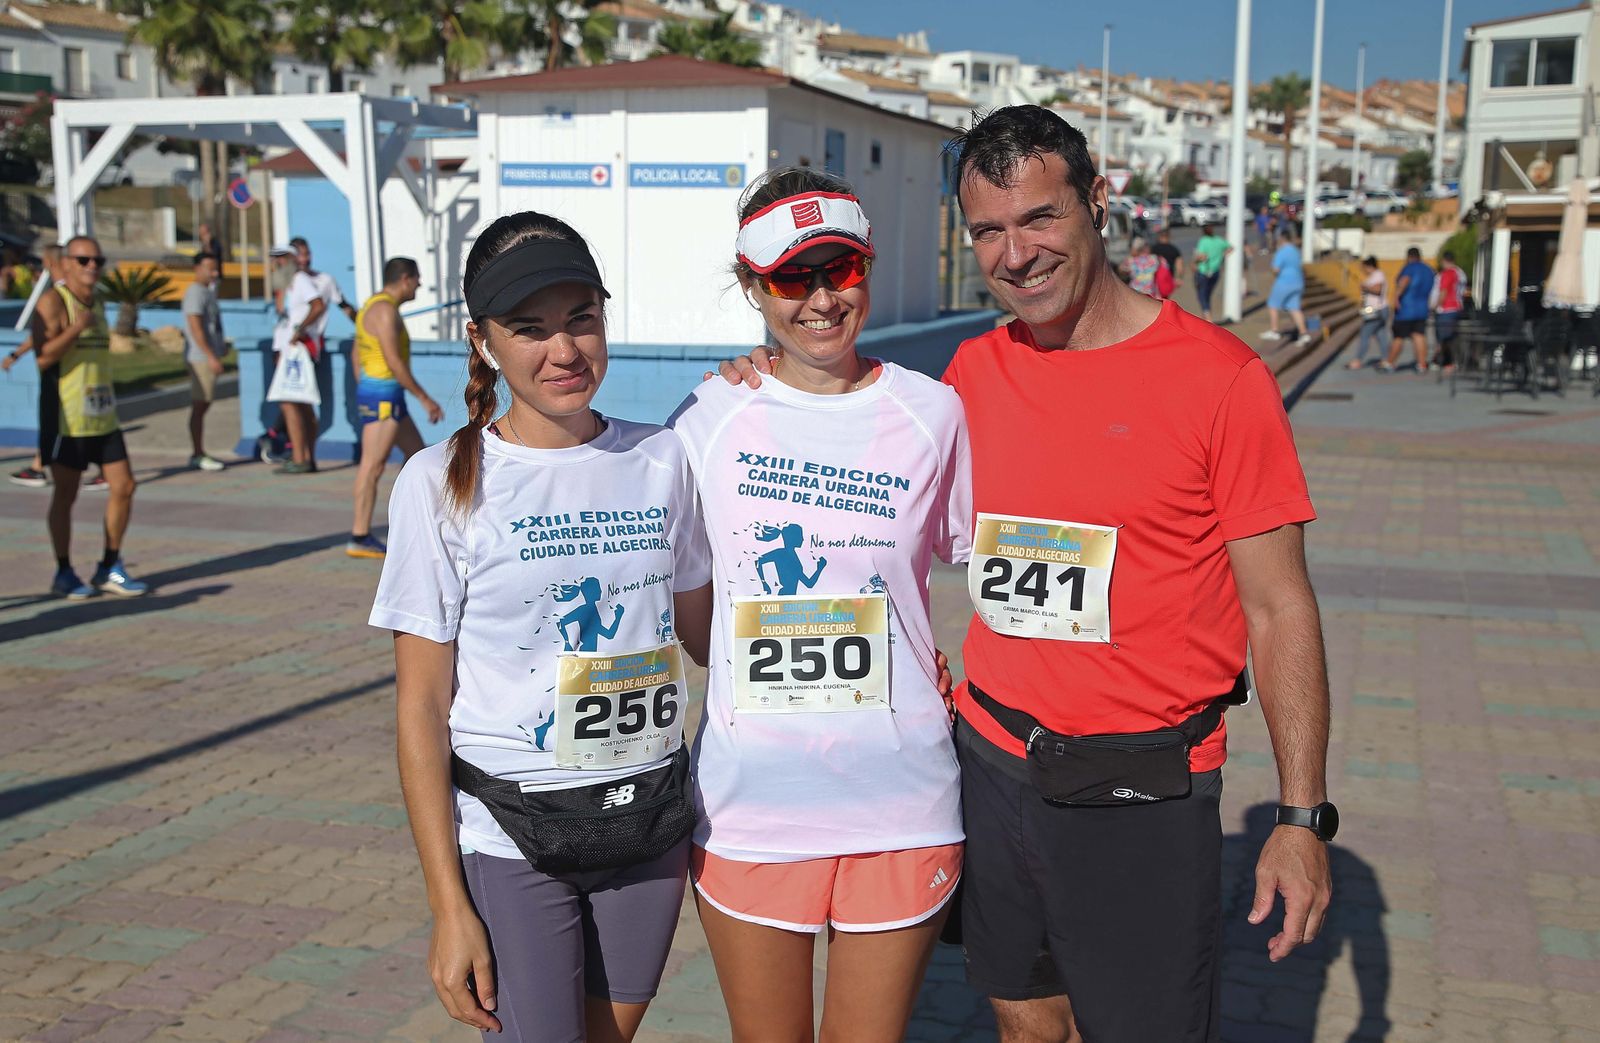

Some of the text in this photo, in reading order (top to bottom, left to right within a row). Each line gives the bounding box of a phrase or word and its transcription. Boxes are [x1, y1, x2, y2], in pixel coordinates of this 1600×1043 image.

[503, 168, 590, 181] PRIMEROS AUXILIOS
[683, 168, 720, 183] LOCAL
[736, 451, 910, 491] XXIII EDICIÓN
[748, 469, 890, 502] CARRERA URBANA
[738, 483, 897, 520] CIUDAD DE ALGECIRAS
[509, 513, 571, 534] XXIII
[527, 521, 664, 543] CARRERA URBANA
[1000, 523, 1017, 534] XXIII
[519, 538, 671, 562] CIUDAD DE ALGECIRAS
[810, 533, 896, 550] No nos detenemos
[996, 545, 1080, 563] CIUDAD DE ALGECIRAS
[607, 579, 620, 599] No
[623, 581, 640, 593] nos
[980, 557, 1086, 612] 241
[760, 603, 780, 614] XXIII
[1002, 605, 1019, 613] GRIMA
[761, 623, 856, 636] CIUDAD DE ALGECIRAS
[591, 660, 612, 670] XXIII
[749, 636, 871, 682] 250
[590, 672, 670, 693] CIUDAD DE ALGECIRAS
[574, 683, 678, 740] 256
